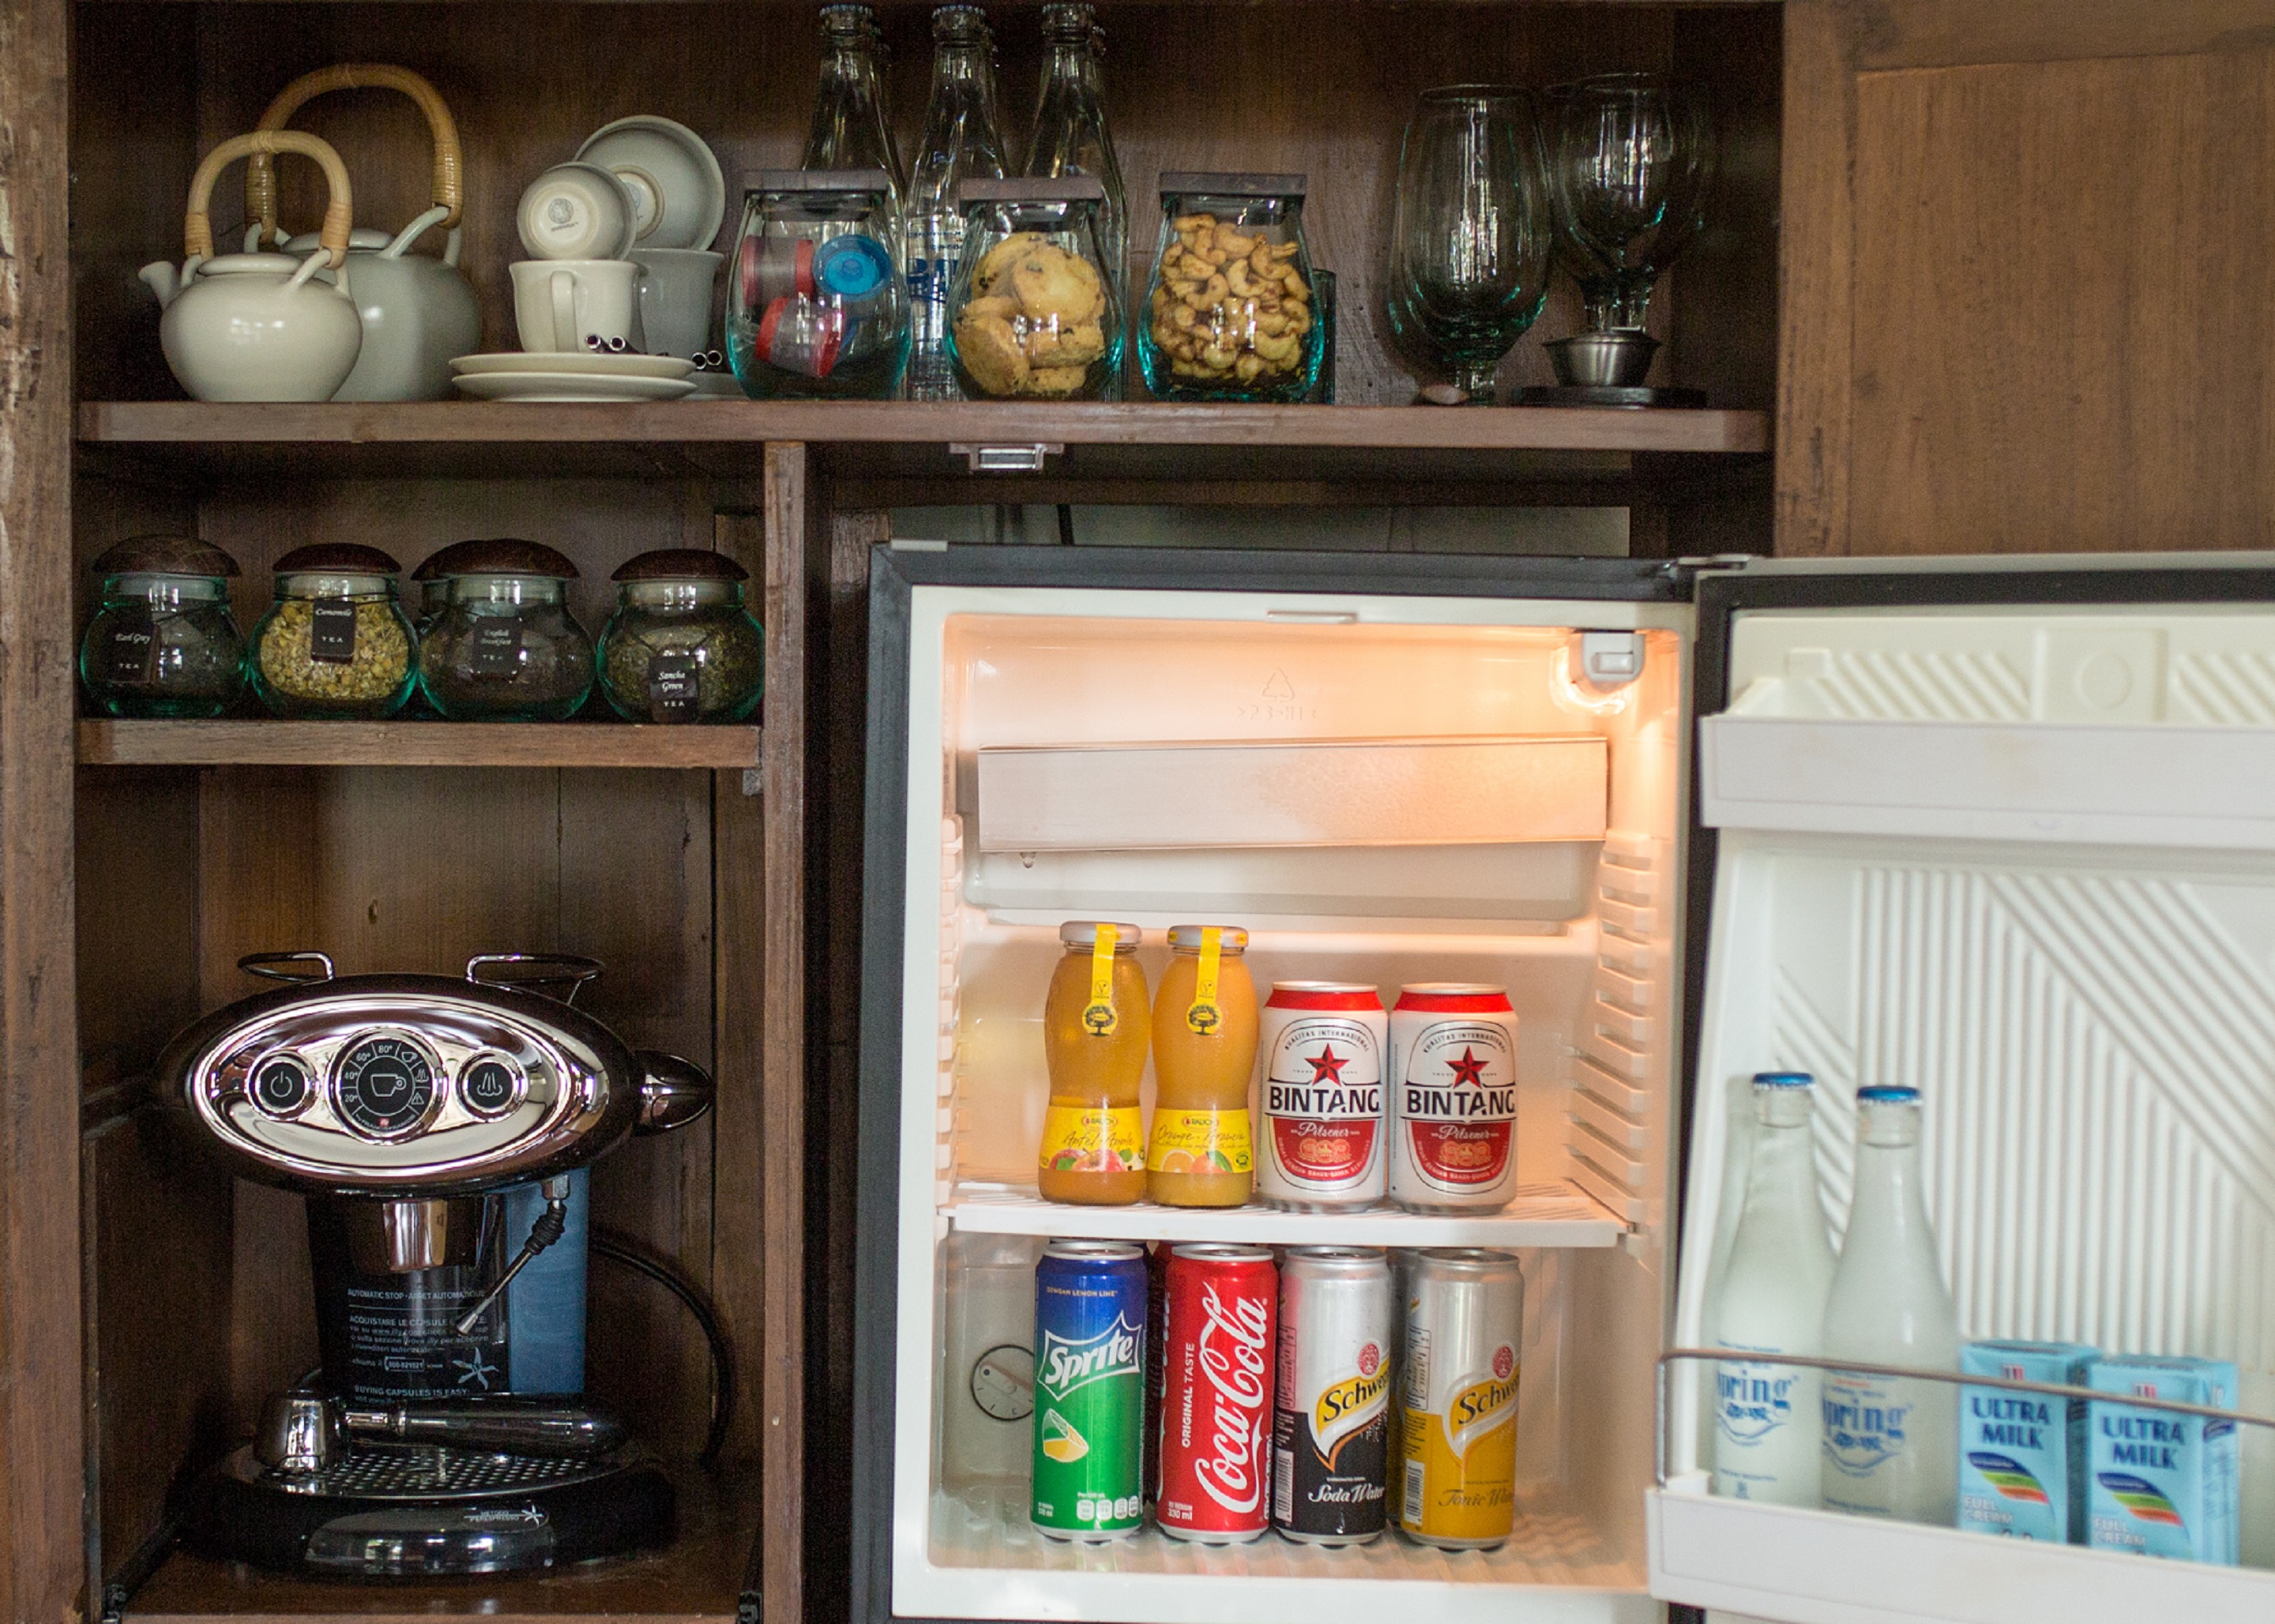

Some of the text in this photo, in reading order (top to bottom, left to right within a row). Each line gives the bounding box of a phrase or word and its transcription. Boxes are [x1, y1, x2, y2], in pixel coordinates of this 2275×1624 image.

[662, 682, 683, 693] Green
[1318, 1030, 1369, 1052] INTERNASIONAL
[1269, 1086, 1379, 1114] BINTANG
[1407, 1089, 1515, 1115] BINTANG
[1298, 1122, 1349, 1137] Pilsener
[1438, 1125, 1489, 1140] Pilsener
[348, 1288, 385, 1299] AUTOMATIC
[385, 1291, 405, 1300] STOP
[350, 1315, 396, 1325] ACQUISTARE
[410, 1318, 447, 1326] CAPSULE
[1045, 1328, 1134, 1389] Sprite
[354, 1385, 384, 1396] BUYING
[386, 1387, 431, 1397] CAPSULES
[432, 1388, 442, 1397] IS
[1182, 1343, 1195, 1448] ORIGINAL TASTE
[1972, 1396, 2051, 1426] ULTRA
[1983, 1423, 2044, 1450] MILK
[2103, 1415, 2185, 1445] ULTRA
[2112, 1442, 2177, 1470] MILK
[1308, 1483, 1350, 1502] Soda
[1438, 1489, 1484, 1507] Tonic
[1965, 1495, 1997, 1510] FULL
[1965, 1510, 2014, 1524] CREAM
[2095, 1517, 2130, 1532] FULL
[2095, 1531, 2146, 1547] CREAM
